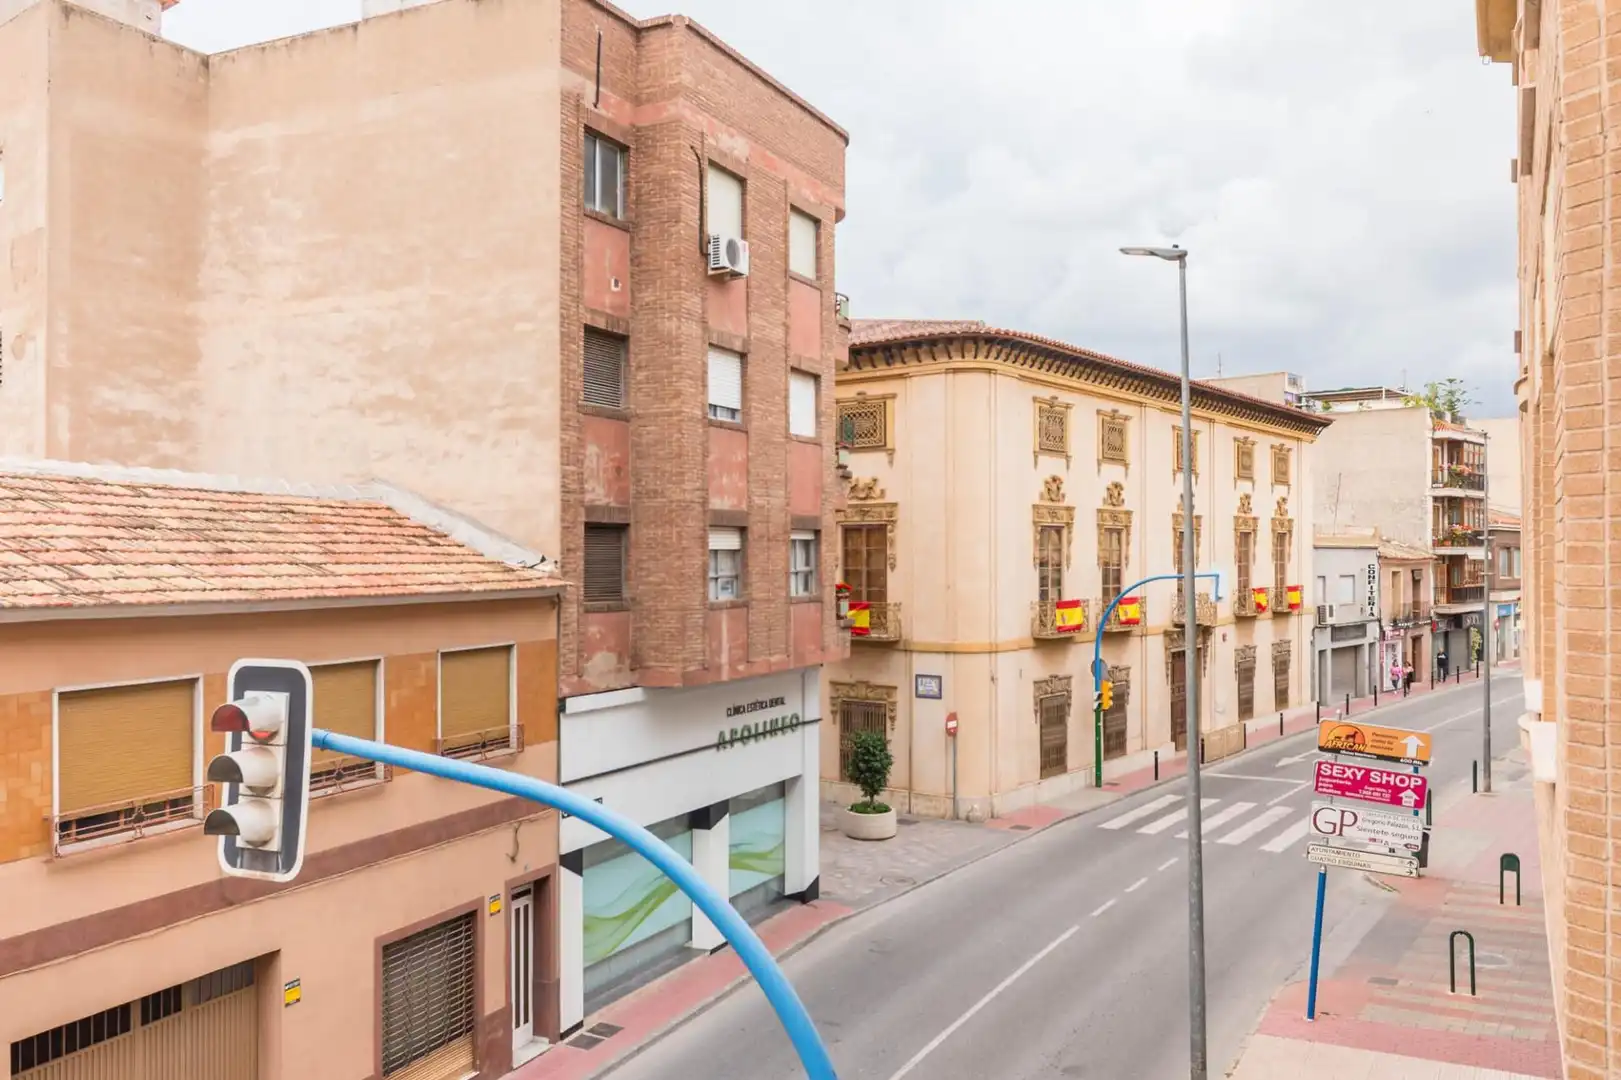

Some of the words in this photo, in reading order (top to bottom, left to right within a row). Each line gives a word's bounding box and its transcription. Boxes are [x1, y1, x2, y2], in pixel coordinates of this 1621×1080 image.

[1323, 739, 1367, 752] AFRICAN
[1320, 763, 1365, 780] SEXY
[1369, 771, 1422, 789] SHOP
[1312, 806, 1358, 837] GP
[1310, 846, 1360, 859] AYUNTAMIENTO
